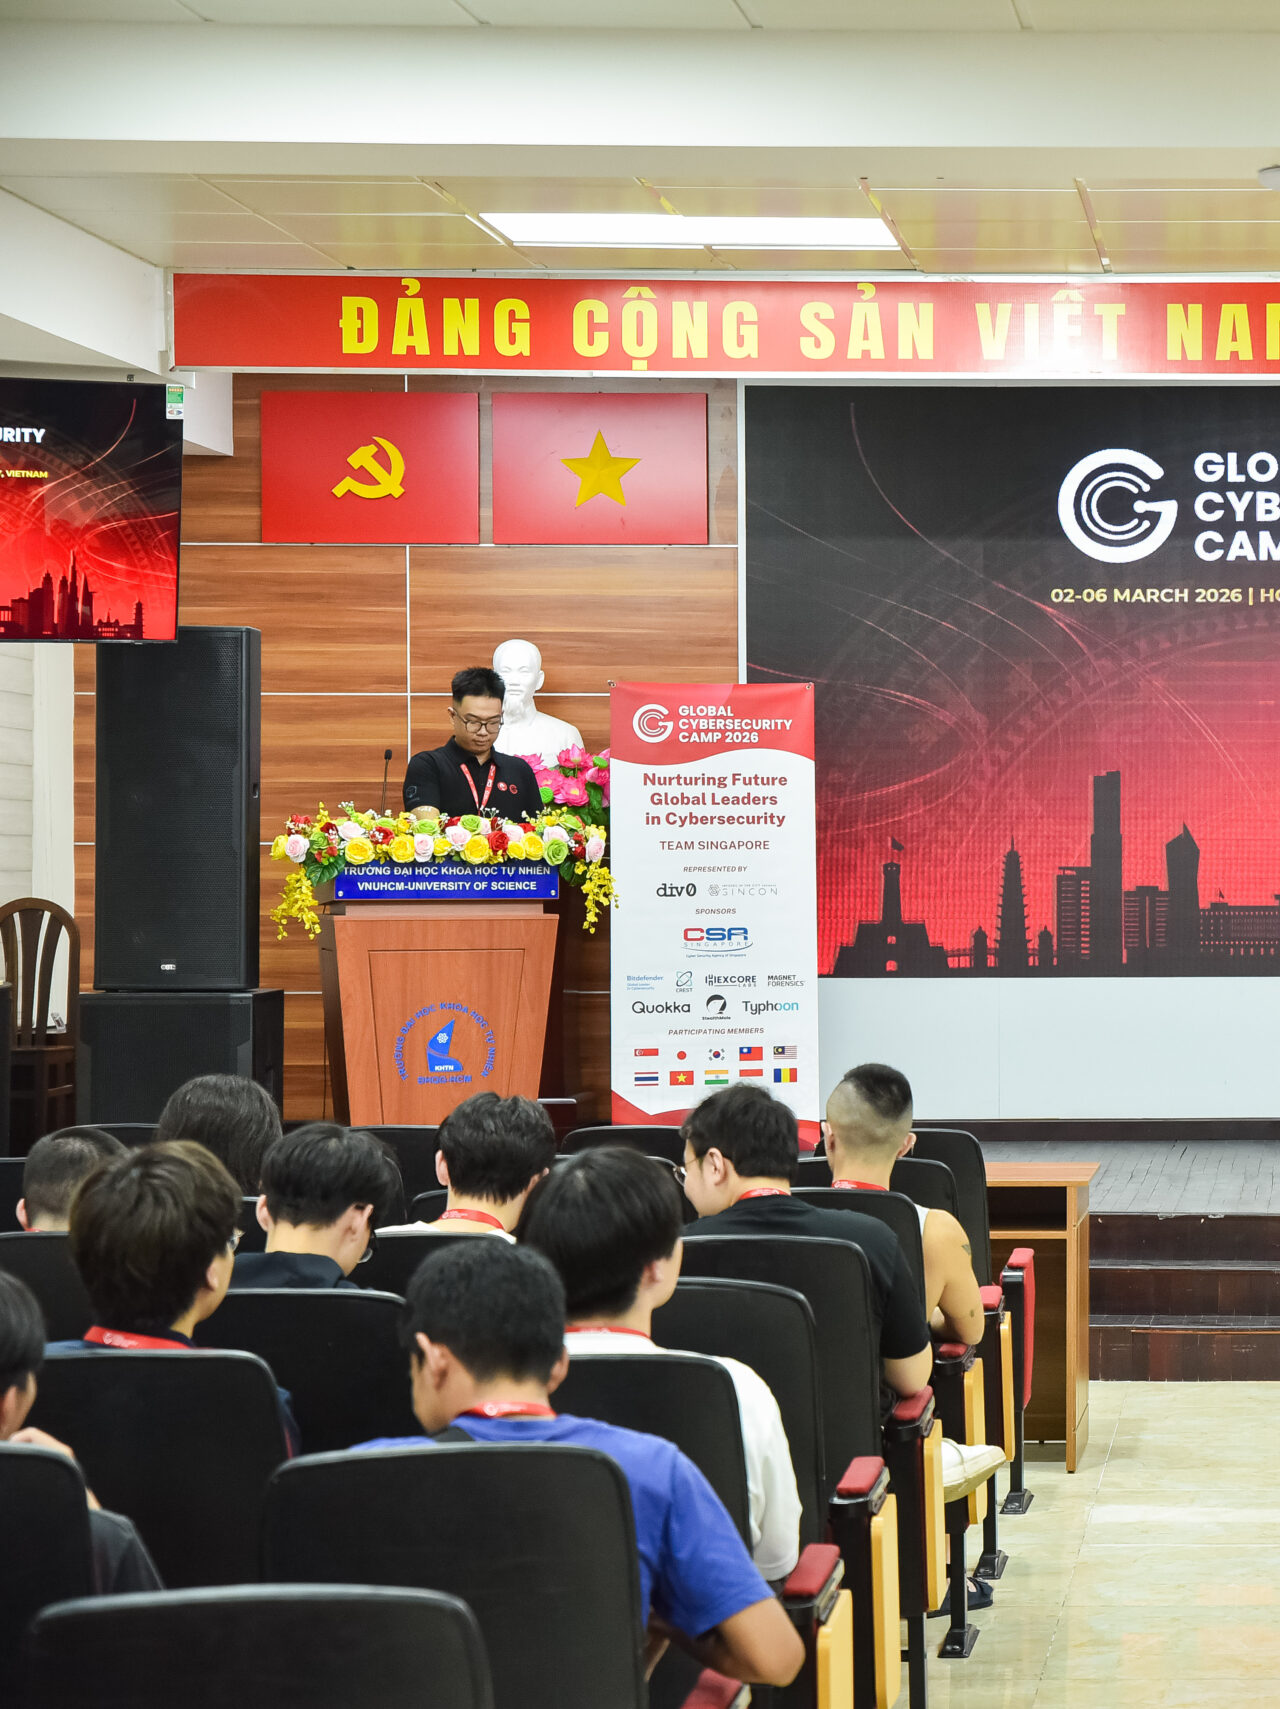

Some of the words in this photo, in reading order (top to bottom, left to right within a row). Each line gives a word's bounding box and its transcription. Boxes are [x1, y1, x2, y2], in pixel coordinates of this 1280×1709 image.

[339, 278, 531, 357] ĐẢNG
[572, 286, 760, 371] CỘNG
[799, 283, 935, 361] SẢN
[0, 427, 46, 444] RITY
[6, 469, 49, 479] VIETNAM
[1050, 588, 1108, 604] 02-06
[1113, 588, 1189, 603] MARCH
[1194, 588, 1243, 603] 2026
[678, 705, 734, 717] GLOBAL
[678, 718, 793, 731] CYBERSECURITY
[678, 732, 722, 743] CAMP
[724, 731, 759, 743] 2026
[643, 772, 728, 789] Nurturing
[731, 772, 788, 786] Future
[650, 792, 707, 806] Global
[711, 792, 778, 806] Leaders
[645, 812, 661, 825] in
[665, 812, 786, 828] Cybersecurity
[659, 840, 695, 850] TEAM
[697, 840, 770, 850] SINGAPORE
[394, 866, 413, 878] ĐẠI
[415, 866, 440, 878] HỌC
[441, 866, 472, 875] KHOA
[474, 866, 498, 878] HỌC
[518, 864, 551, 875] NHIÊN
[357, 881, 471, 891] VNUHCM-UNIVERSITY
[474, 881, 488, 890] OF
[490, 881, 537, 890] SCIENCE
[721, 887, 778, 896] SINCON
[683, 927, 748, 942] CSA
[440, 1002, 469, 1014] KHOA
[631, 1000, 691, 1014] Quokka
[742, 1000, 799, 1015] Typhoon
[668, 1028, 726, 1036] PARTICIPATING
[727, 1027, 765, 1035] MEMBERS
